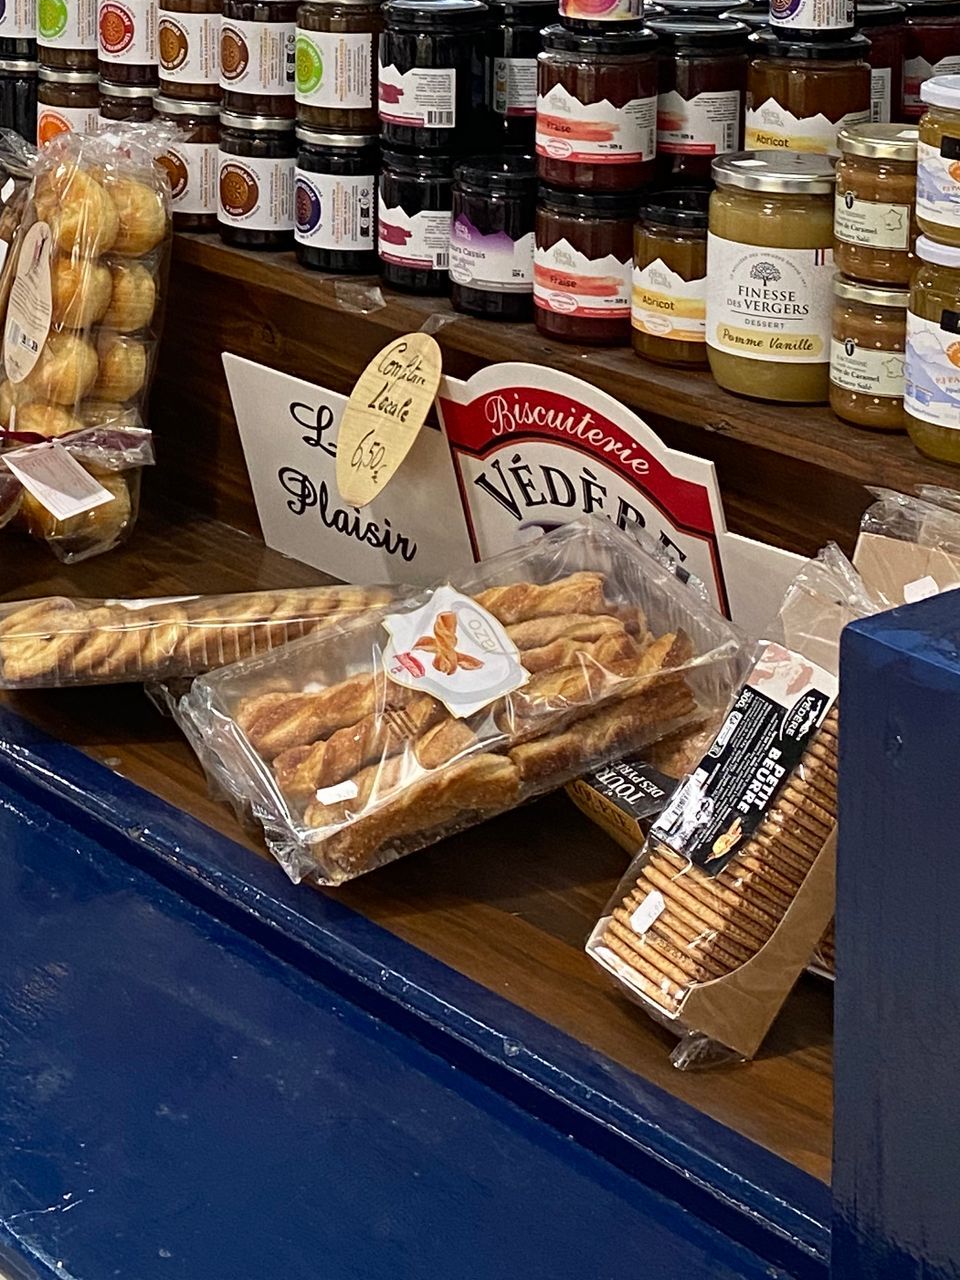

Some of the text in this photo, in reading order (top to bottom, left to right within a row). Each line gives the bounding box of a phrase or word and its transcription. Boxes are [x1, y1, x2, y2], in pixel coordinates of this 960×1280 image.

[546, 120, 572, 133] Fraise
[755, 134, 790, 148] Abricot
[851, 224, 878, 234] Caramel
[549, 274, 577, 288] Fraise
[737, 284, 797, 302] FINESSE
[642, 294, 675, 311] Abricot
[726, 297, 810, 316] DES VERGERS
[744, 318, 785, 329] DESSERT
[722, 327, 815, 352] Pomme Vanille
[851, 371, 880, 383] Caramel
[368, 382, 413, 423] Locale
[484, 394, 650, 475] Biscuiterie
[278, 466, 418, 562] Plaisir
[736, 746, 782, 815] BEURRE
[751, 763, 786, 811] PETIT
